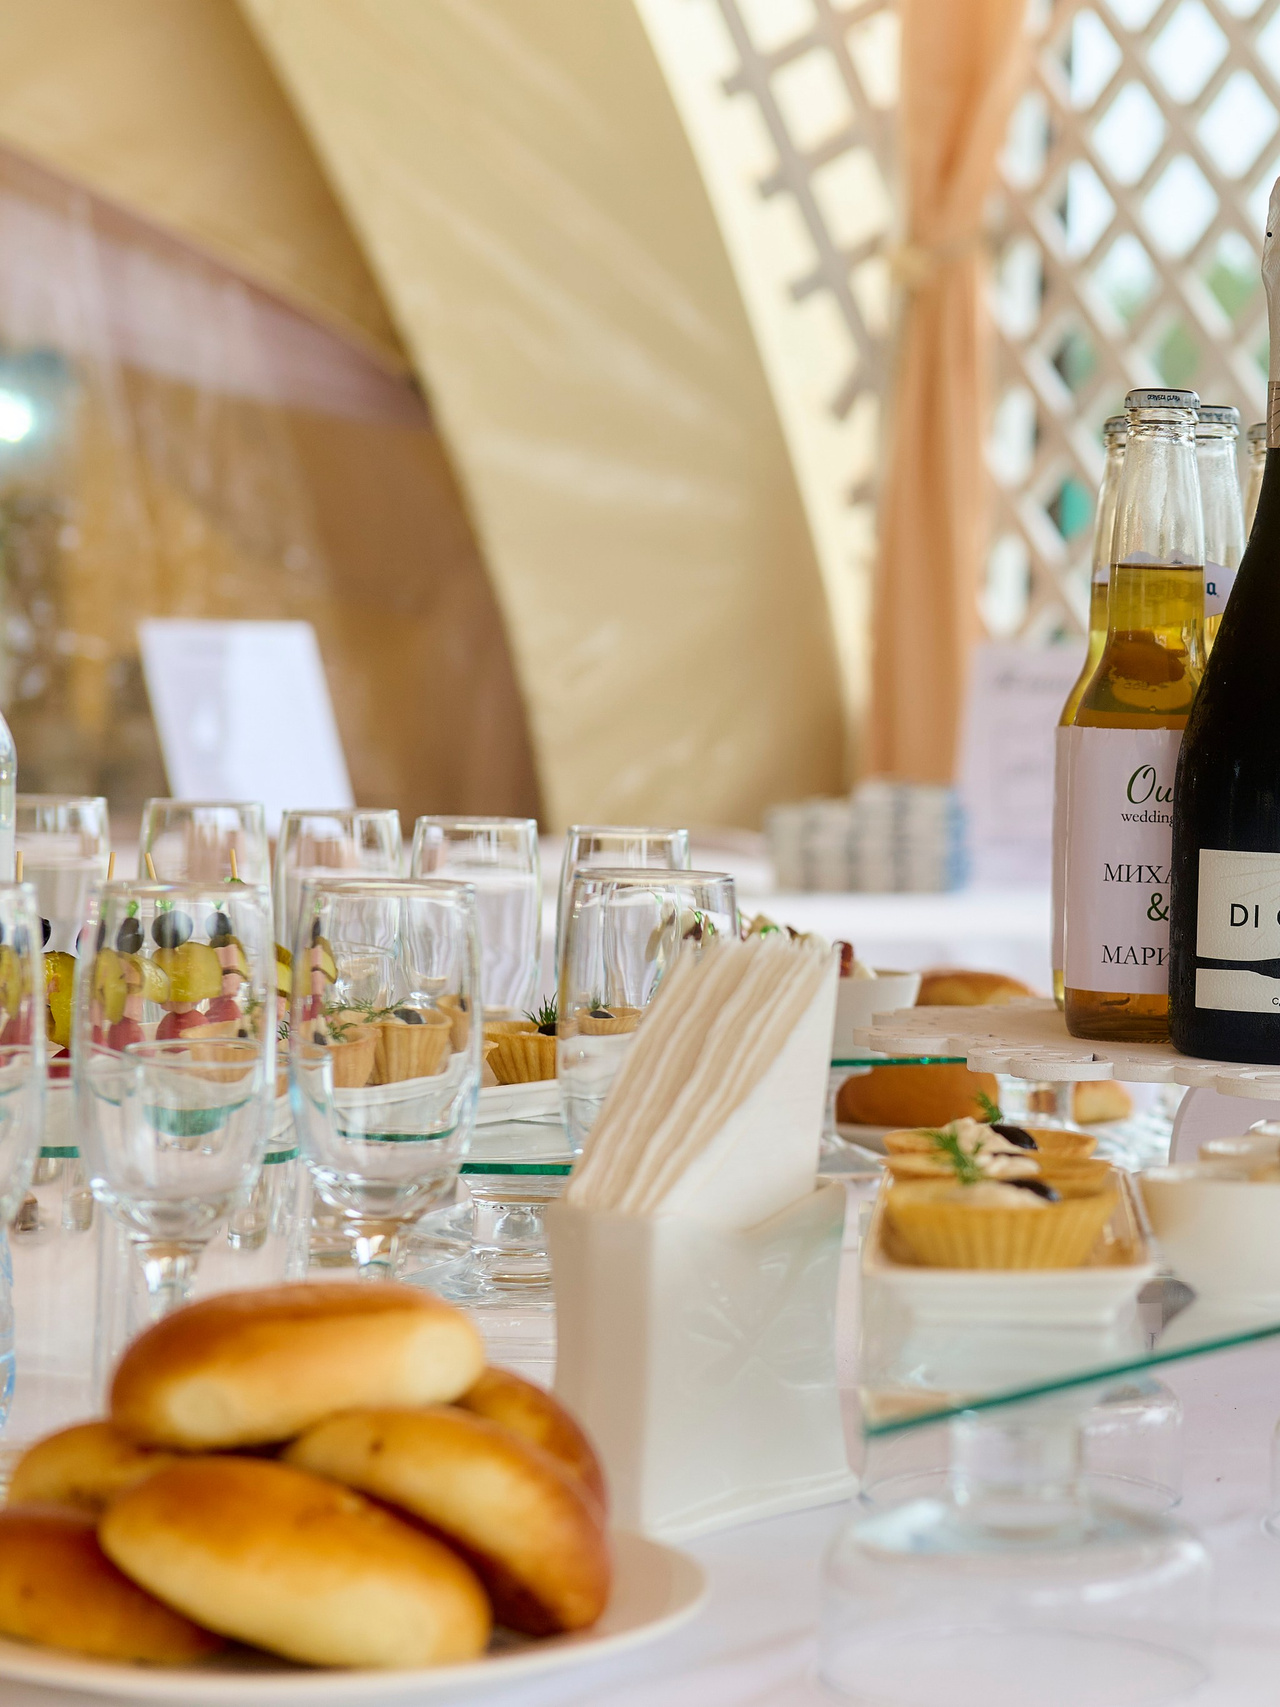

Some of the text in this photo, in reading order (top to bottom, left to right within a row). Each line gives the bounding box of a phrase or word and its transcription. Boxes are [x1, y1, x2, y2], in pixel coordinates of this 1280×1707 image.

[1126, 764, 1174, 805] Ou
[1146, 892, 1170, 922] &
[1230, 903, 1260, 928] DI
